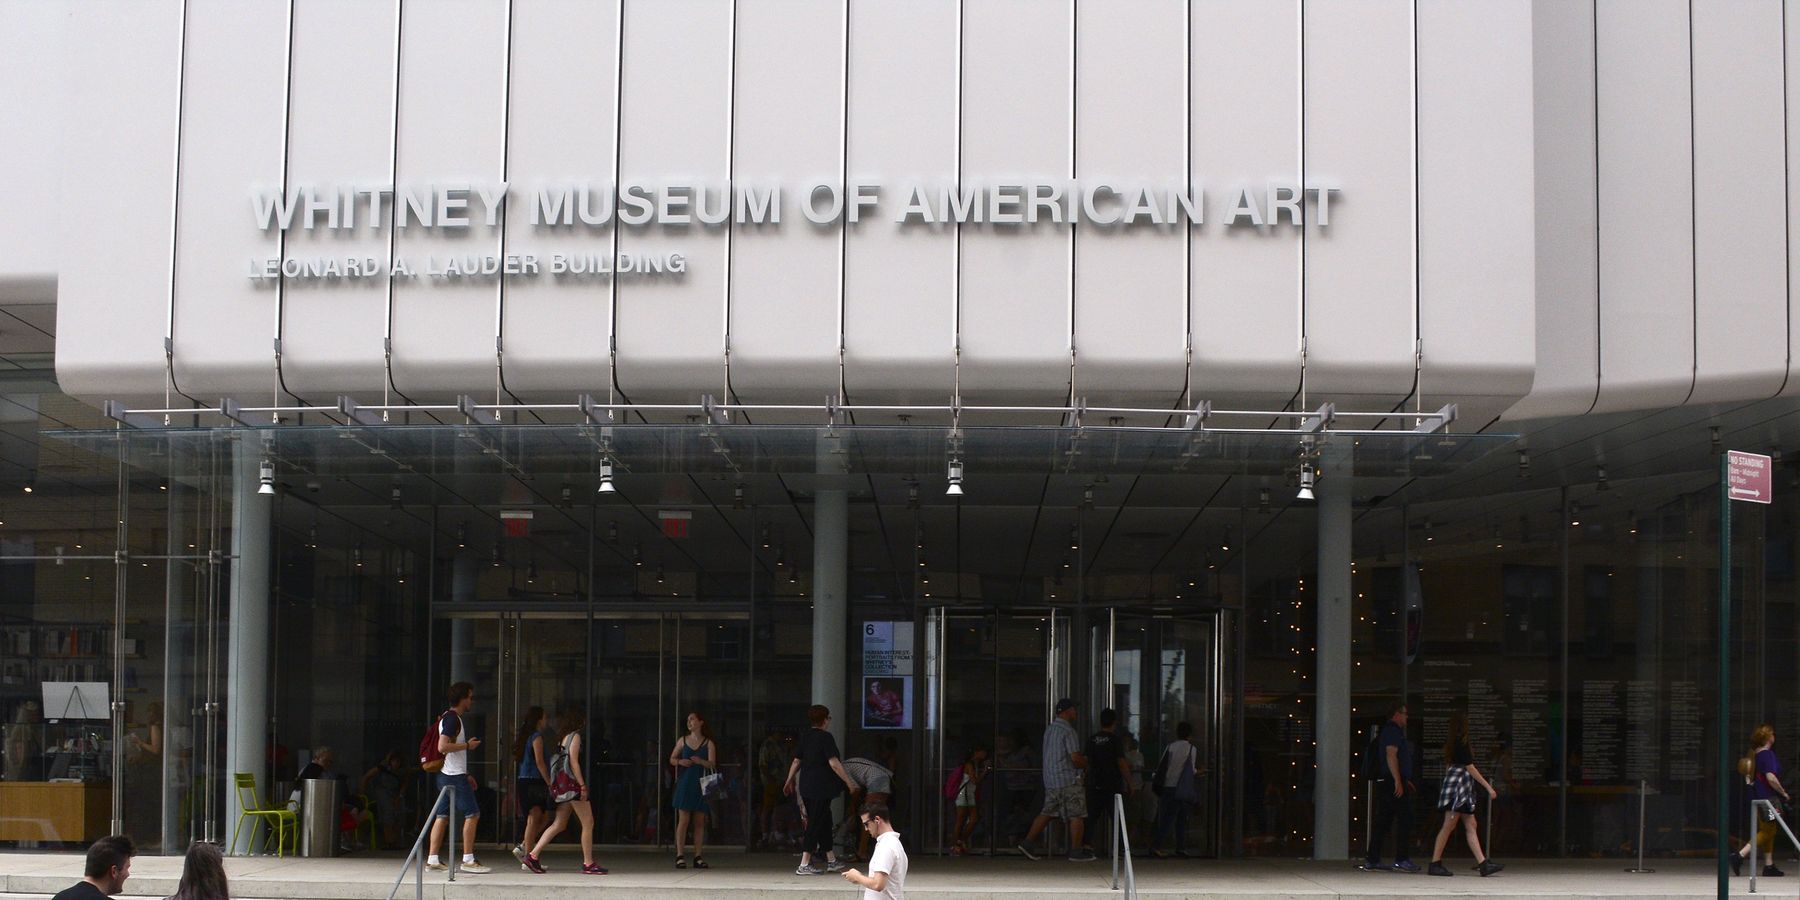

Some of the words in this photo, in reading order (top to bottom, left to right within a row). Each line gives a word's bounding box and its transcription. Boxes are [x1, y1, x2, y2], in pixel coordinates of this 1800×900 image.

[250, 181, 511, 230] WHITNEY
[529, 180, 781, 225] MUSEUM
[800, 181, 881, 225] OF
[895, 181, 1204, 225] AMERICAN
[1223, 182, 1341, 226] ART
[248, 255, 381, 279] LEONARD
[391, 255, 417, 277] A.
[426, 254, 539, 277] LAUDER
[550, 253, 686, 274] BUILDING
[1730, 456, 1738, 465] NO
[1739, 457, 1764, 469] STANDING
[866, 624, 875, 636] 6
